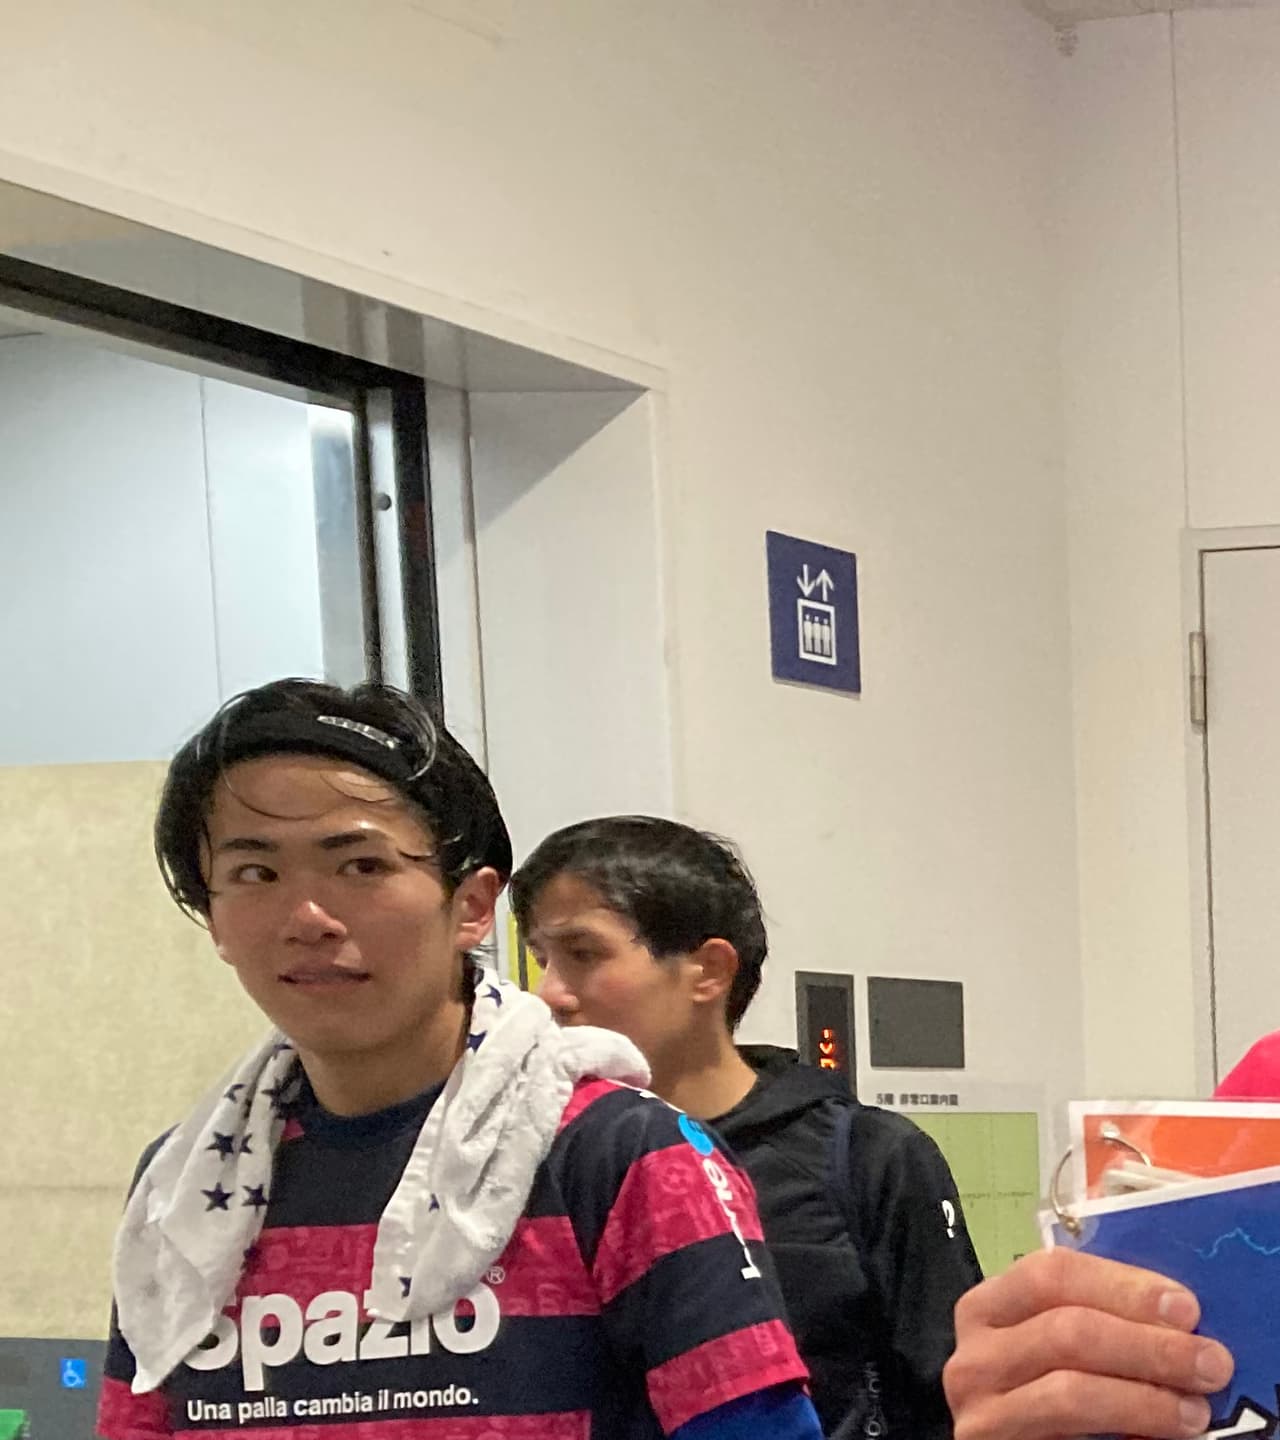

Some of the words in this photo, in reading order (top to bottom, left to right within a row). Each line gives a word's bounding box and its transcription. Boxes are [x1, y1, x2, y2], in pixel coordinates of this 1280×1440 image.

[186, 1400, 231, 1421] Una
[238, 1396, 286, 1424] palla
[293, 1392, 372, 1416] cambia
[378, 1389, 390, 1411] il
[394, 1384, 480, 1408] mondo.
